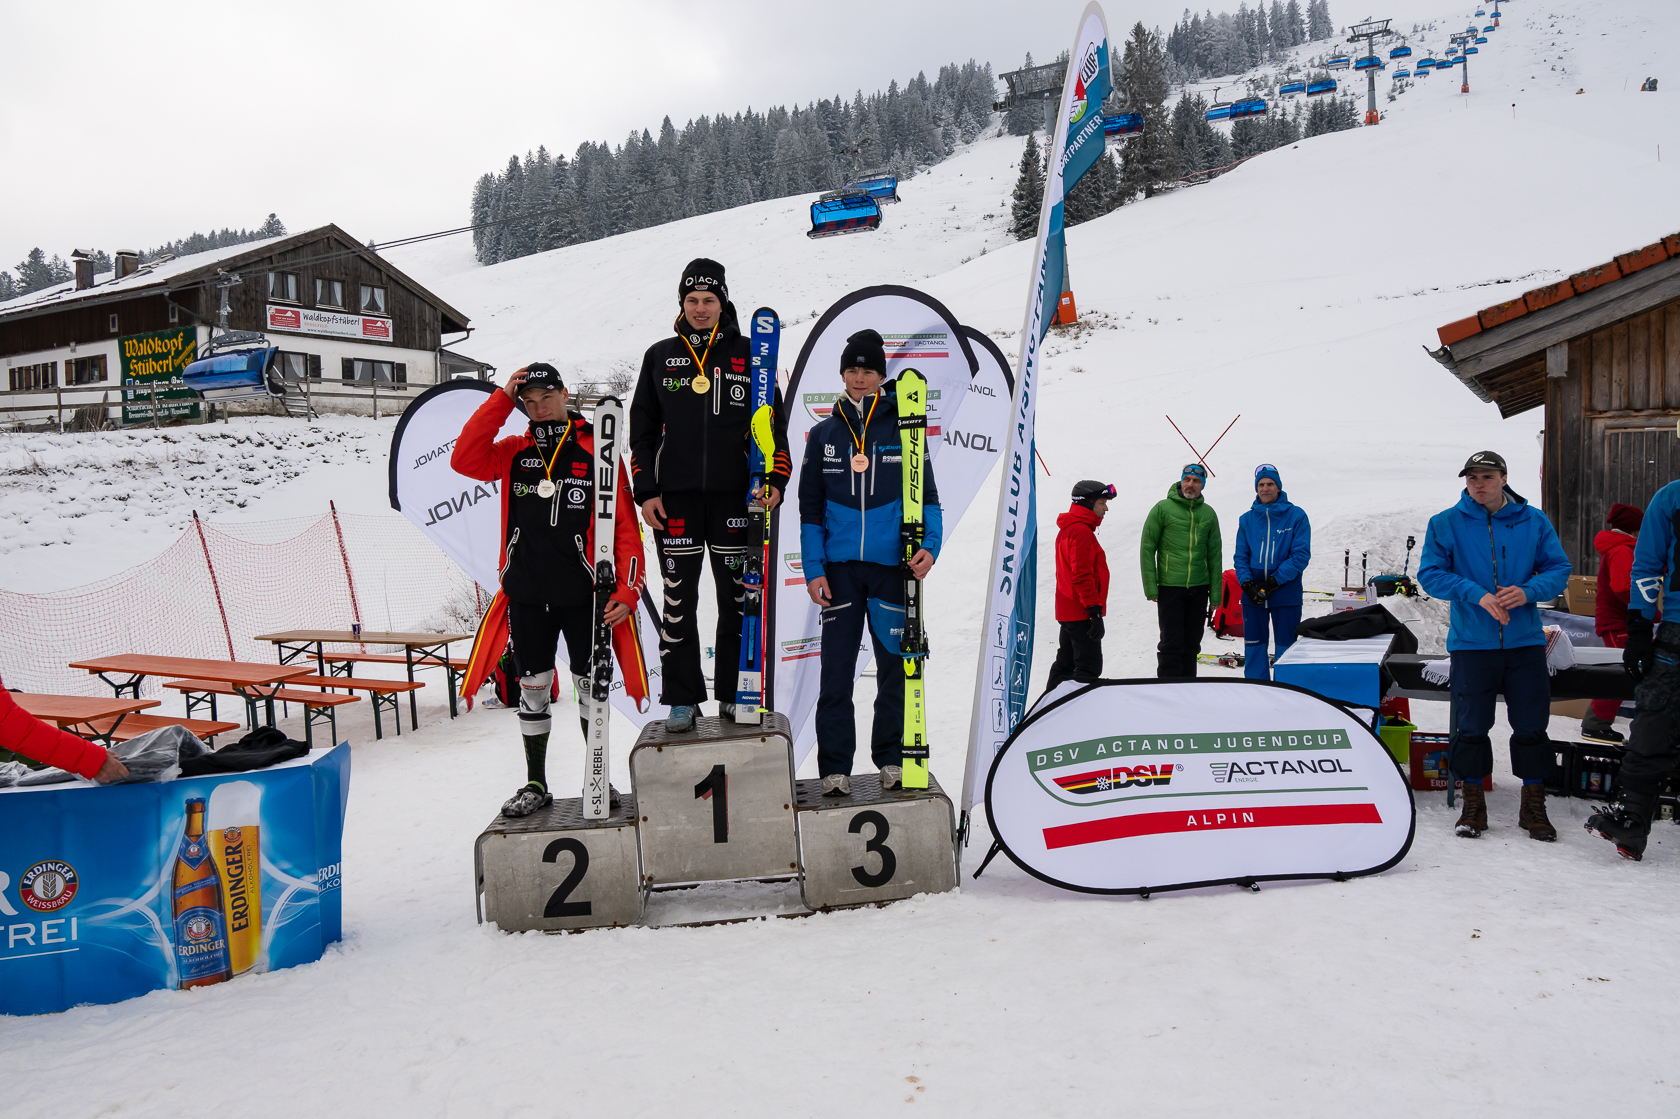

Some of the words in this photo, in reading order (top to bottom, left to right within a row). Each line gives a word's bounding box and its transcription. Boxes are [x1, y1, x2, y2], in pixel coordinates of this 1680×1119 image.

[124, 332, 184, 357] Waldkopf
[129, 355, 173, 377] Stüberl
[725, 373, 751, 383] WÜRTH
[598, 413, 616, 520] HEAD
[564, 477, 592, 487] WÜRTH
[662, 537, 693, 545] WÜRTH
[592, 745, 604, 776] REBEL
[1036, 747, 1080, 767] DSV
[1096, 738, 1199, 756] ACTANOL
[1213, 733, 1343, 749] JUGENDCUP
[1112, 763, 1175, 789] DSV
[1227, 758, 1353, 783] ACTANOL
[592, 793, 602, 816] e-SL
[694, 764, 730, 844] 1
[1186, 812, 1255, 827] ALPIN
[847, 809, 898, 888] 3
[23, 861, 75, 886] ERDINGER
[541, 837, 593, 918] 2
[224, 840, 250, 934] ERDINGER
[178, 939, 226, 957] ERDINGER
